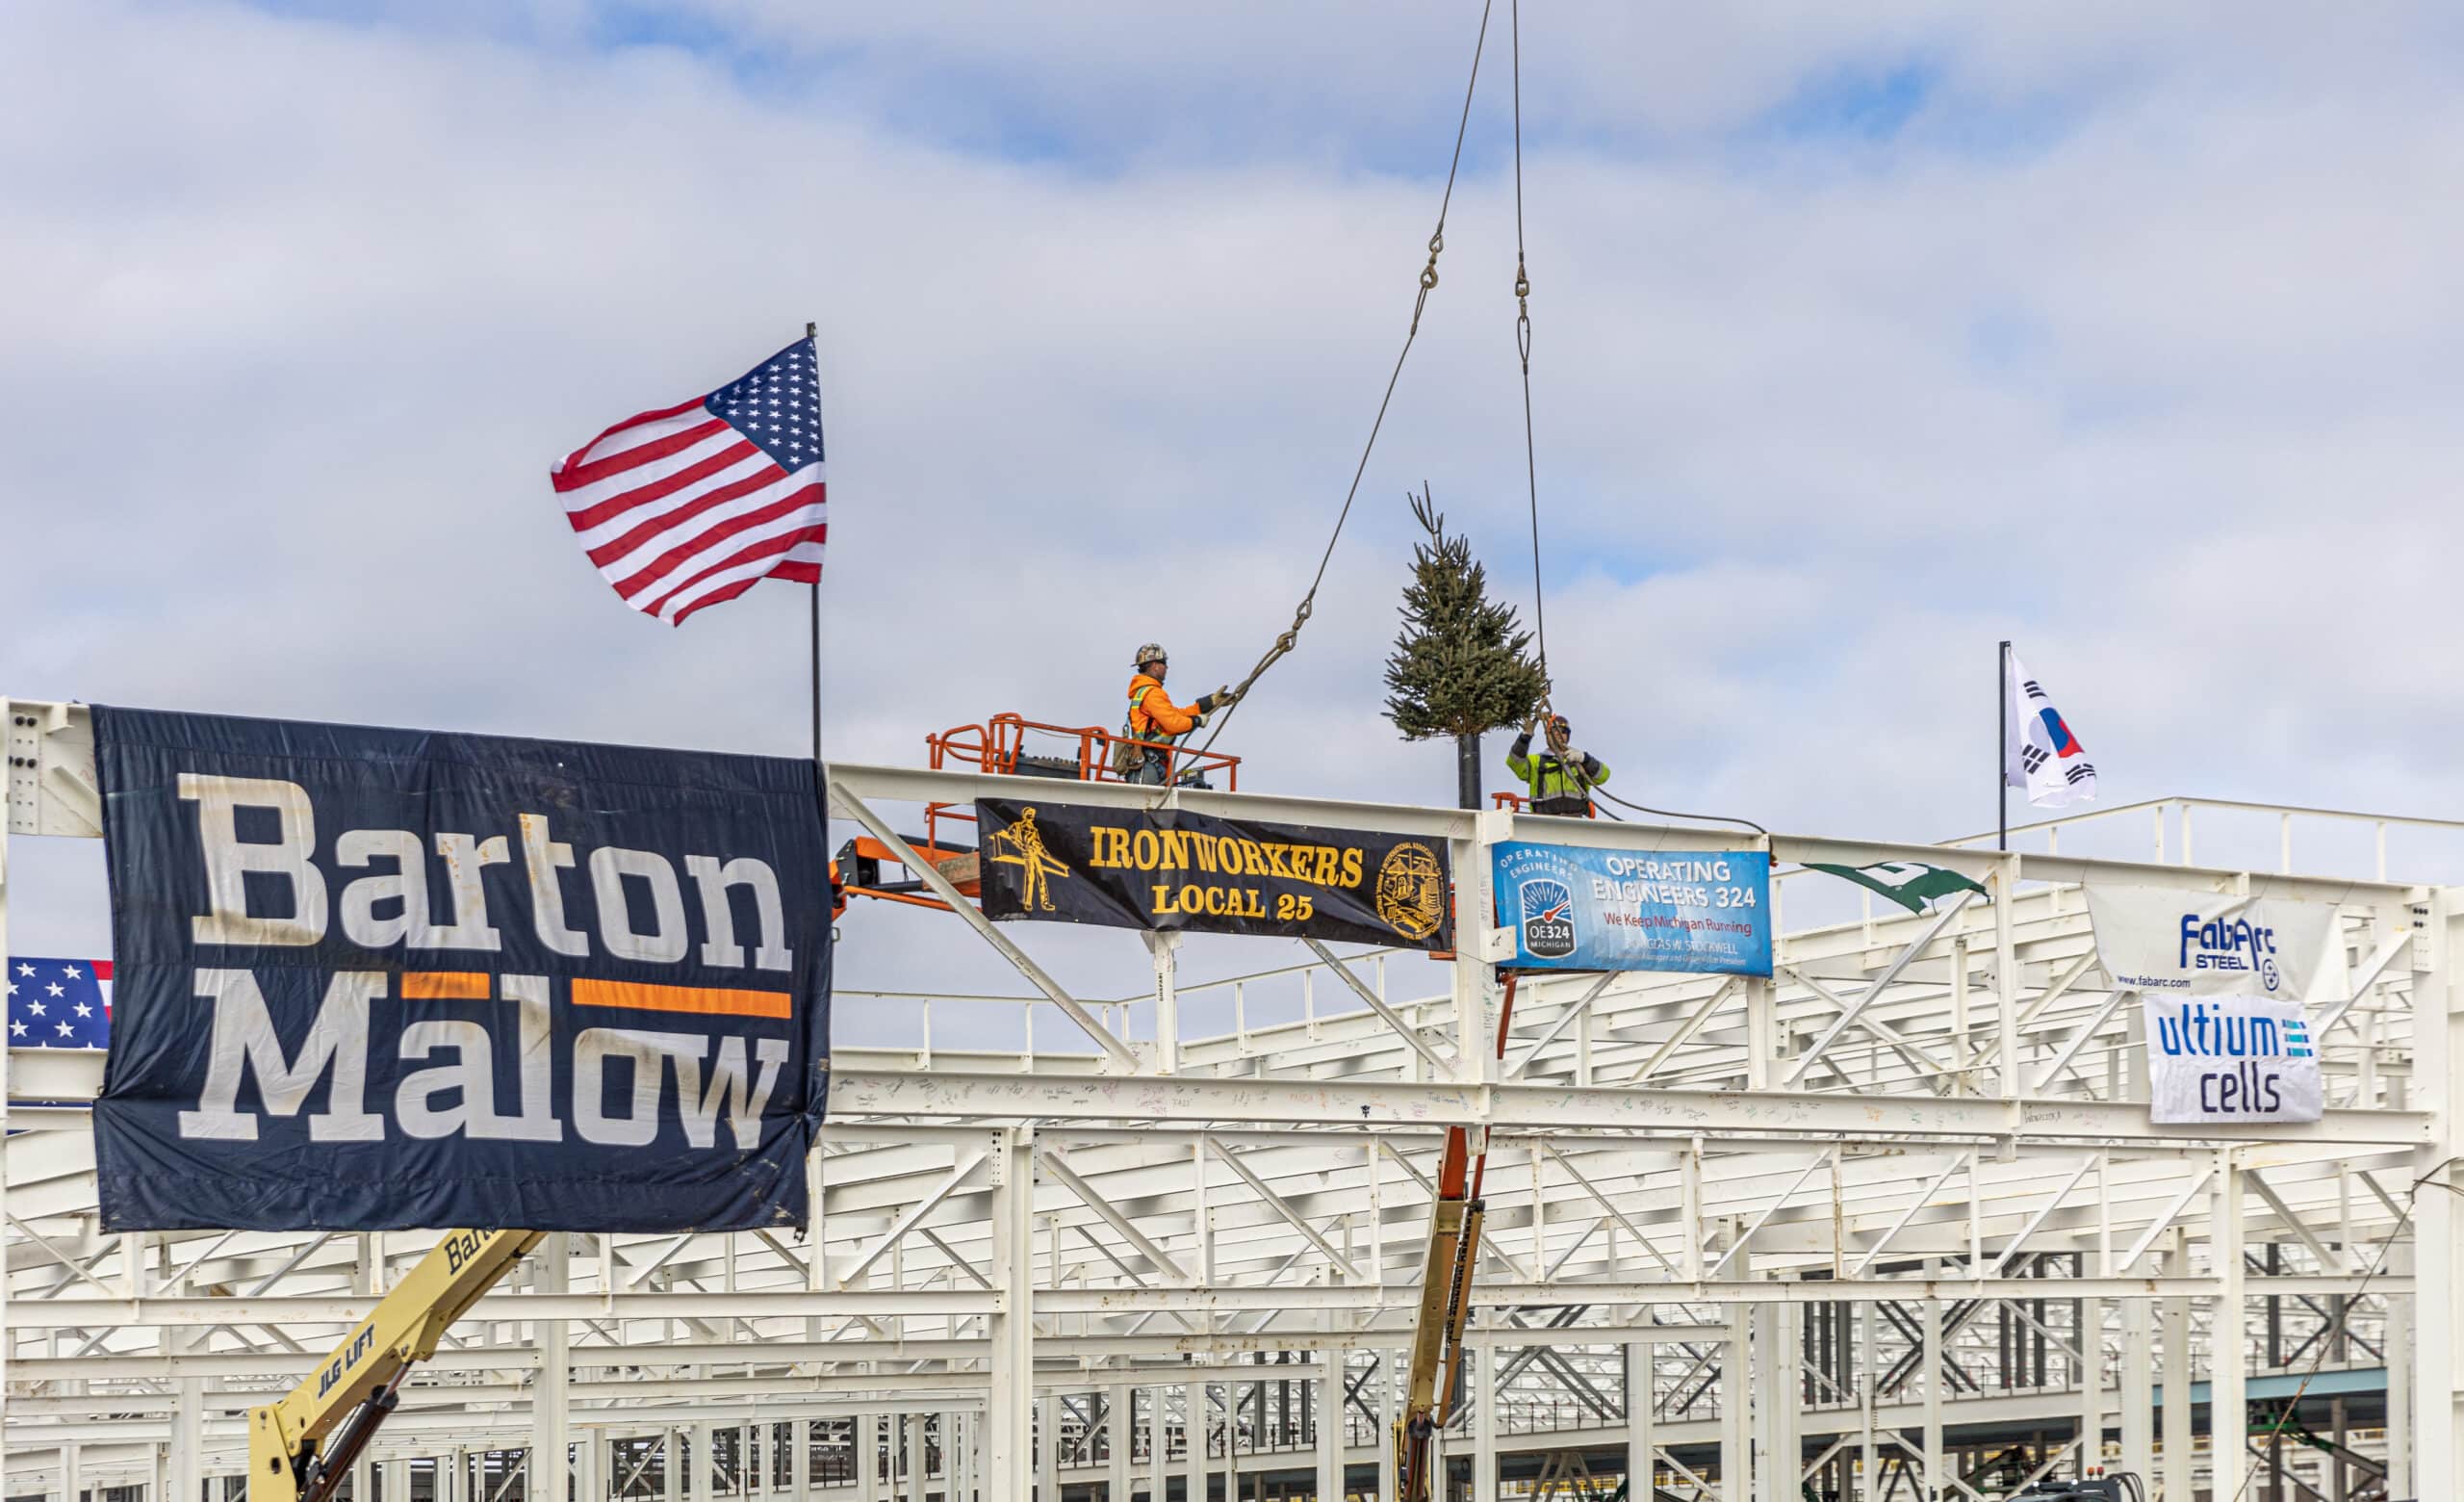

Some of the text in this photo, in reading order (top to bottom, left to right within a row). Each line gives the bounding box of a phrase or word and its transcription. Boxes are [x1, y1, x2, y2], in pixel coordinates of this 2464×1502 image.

[177, 772, 793, 972] Barton
[1089, 825, 1365, 890] IRONWORKERS
[1501, 848, 1578, 872] OPERATING
[1510, 862, 1573, 880] ENGINEERS
[1606, 856, 1732, 883] OPERATING
[1151, 885, 1314, 921] LOCAL 25
[1592, 878, 1757, 908] ENGINEERS 324
[1529, 925, 1571, 939] OE324
[1604, 912, 1753, 937] We Keep Michigan Running
[2179, 914, 2276, 971] FabArc
[2195, 954, 2249, 971] STEEL
[2118, 974, 2191, 988] www.fabarc.com
[2159, 1003, 2279, 1056] ultium
[178, 968, 790, 1150] Malow
[2200, 1061, 2280, 1113] cells
[319, 1323, 374, 1399] JLG LIFT
